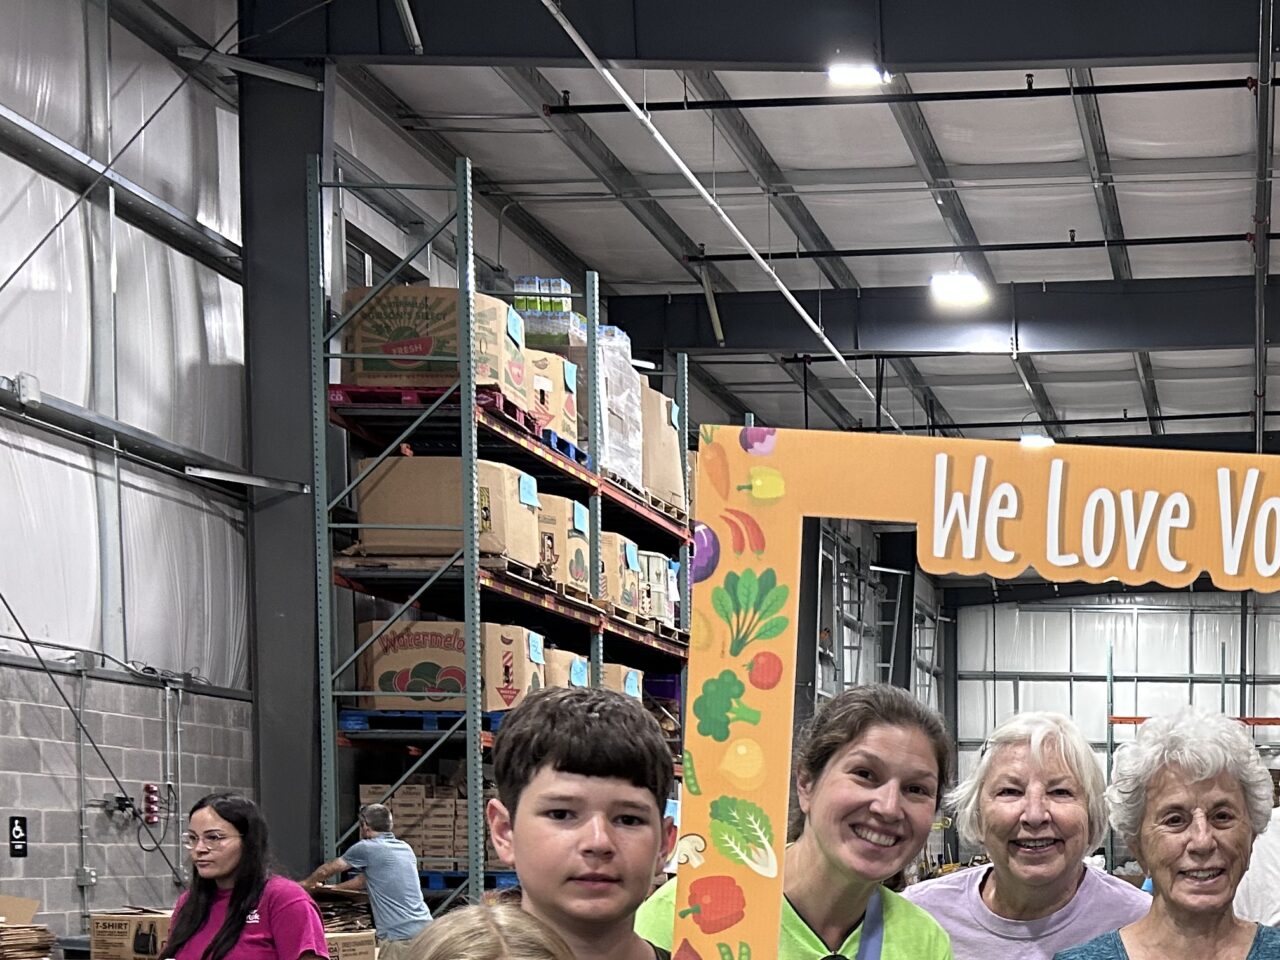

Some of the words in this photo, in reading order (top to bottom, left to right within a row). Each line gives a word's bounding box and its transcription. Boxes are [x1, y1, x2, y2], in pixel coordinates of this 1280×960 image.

[932, 452, 1019, 564] We
[1044, 458, 1192, 573] Love
[95, 921, 128, 930] T-SHIRT
